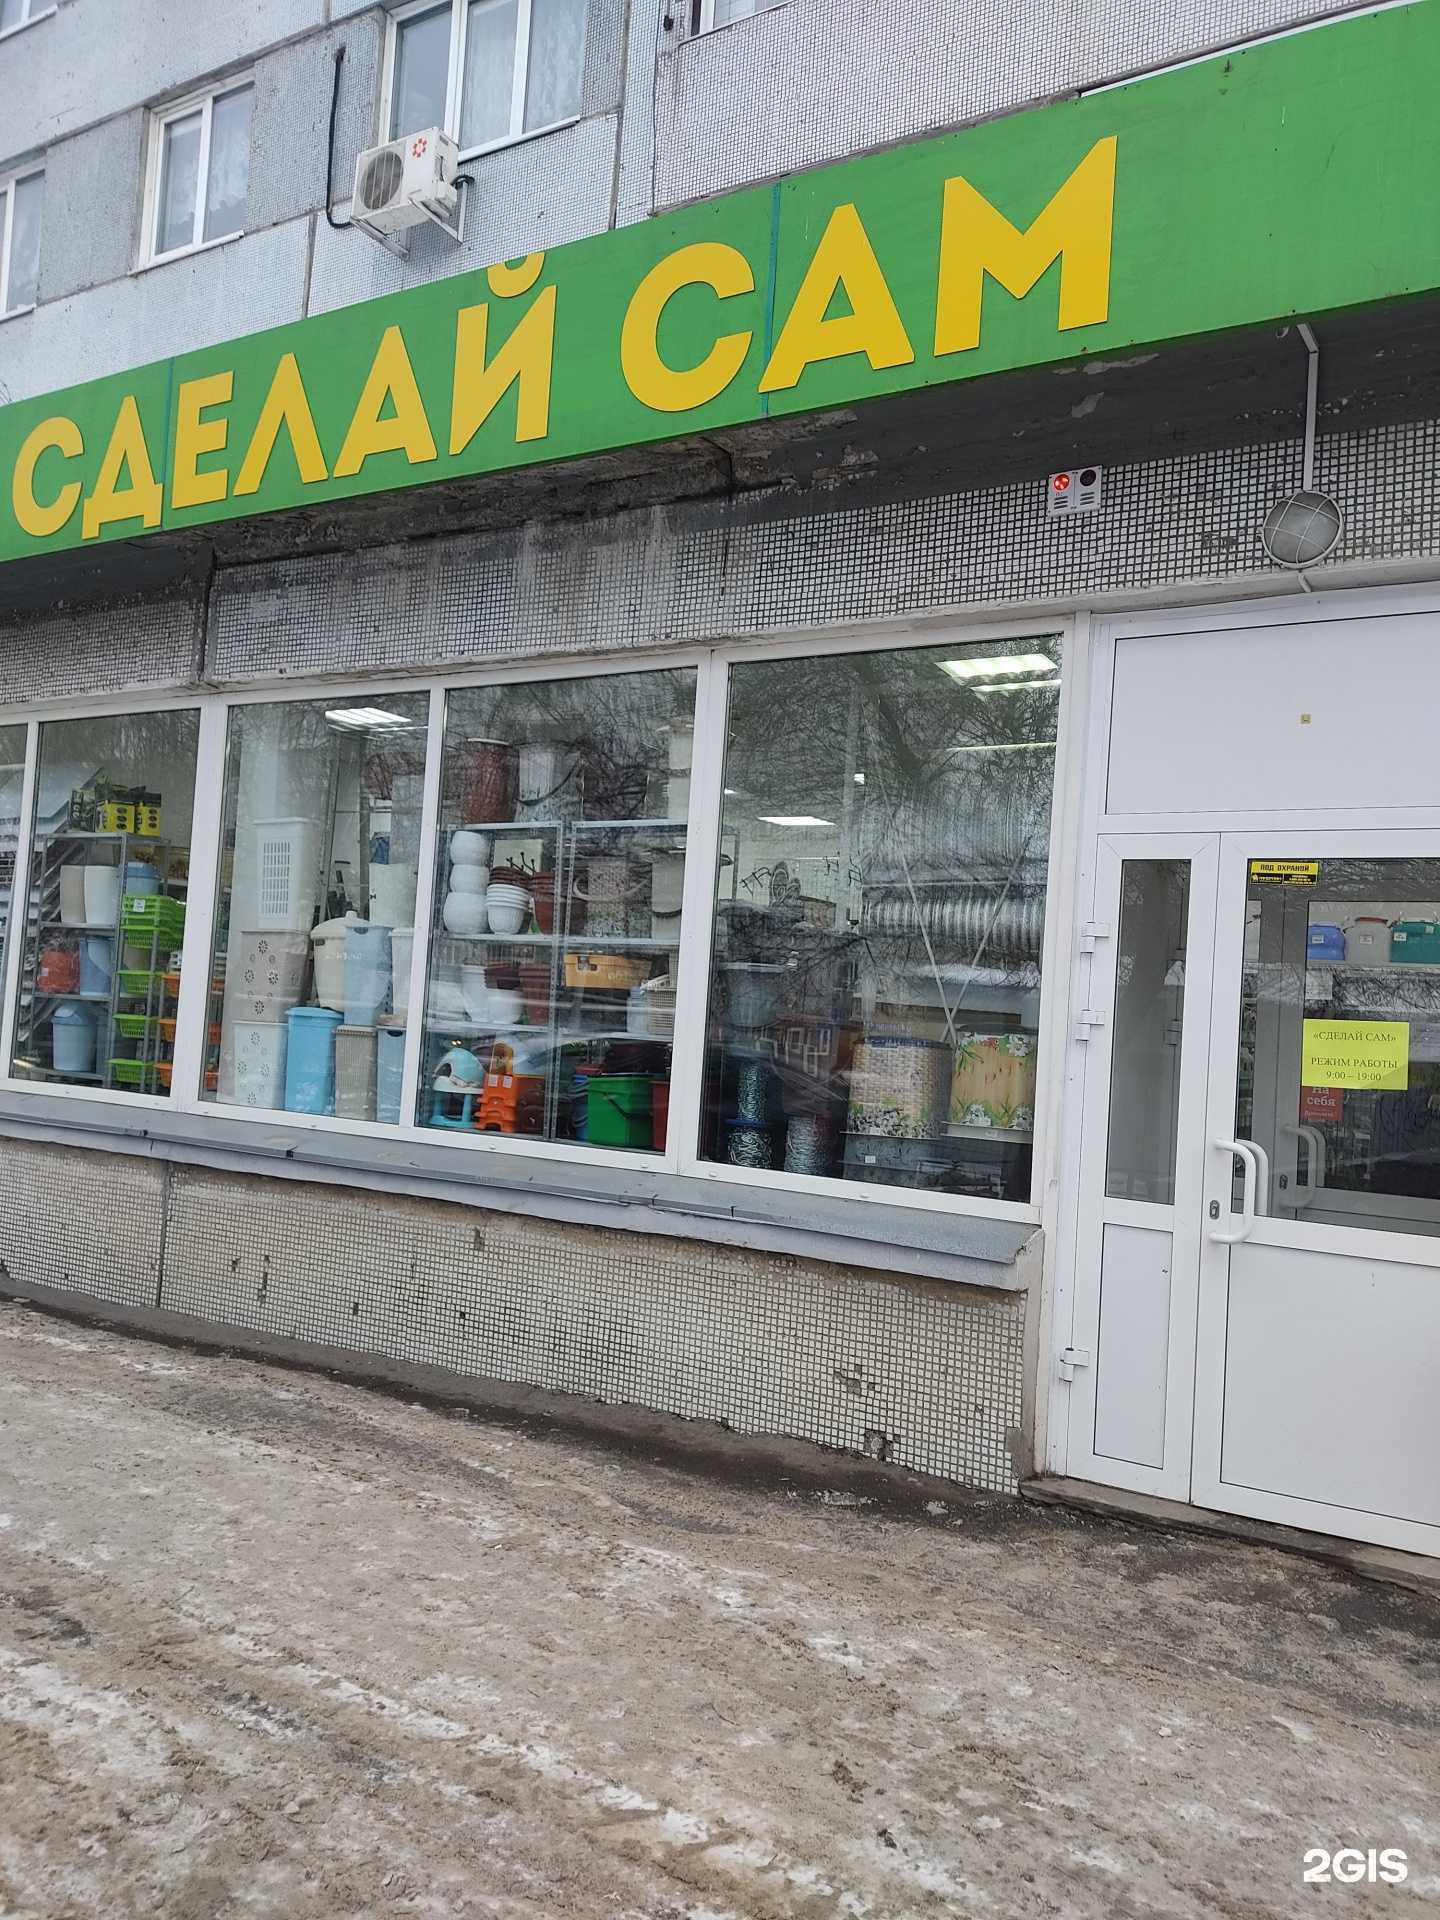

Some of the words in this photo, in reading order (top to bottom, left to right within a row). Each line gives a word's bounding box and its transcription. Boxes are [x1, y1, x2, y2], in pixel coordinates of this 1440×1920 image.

[13, 252, 556, 539] СДЕЛАЙ
[621, 136, 1118, 412] САМ
[1260, 864, 1274, 872] ПОД
[1277, 864, 1310, 872] ОХРАНОЙ
[1313, 1031, 1363, 1041] «СДЕЛАЙ
[1365, 1032, 1397, 1042] САМ»
[1311, 1057, 1350, 1067] РЕЖИМ
[1353, 1059, 1398, 1069] РАБОТЫ
[1326, 1071, 1346, 1080] 9:00
[1357, 1072, 1382, 1081] 19:00
[1307, 1096, 1336, 1106] себя
